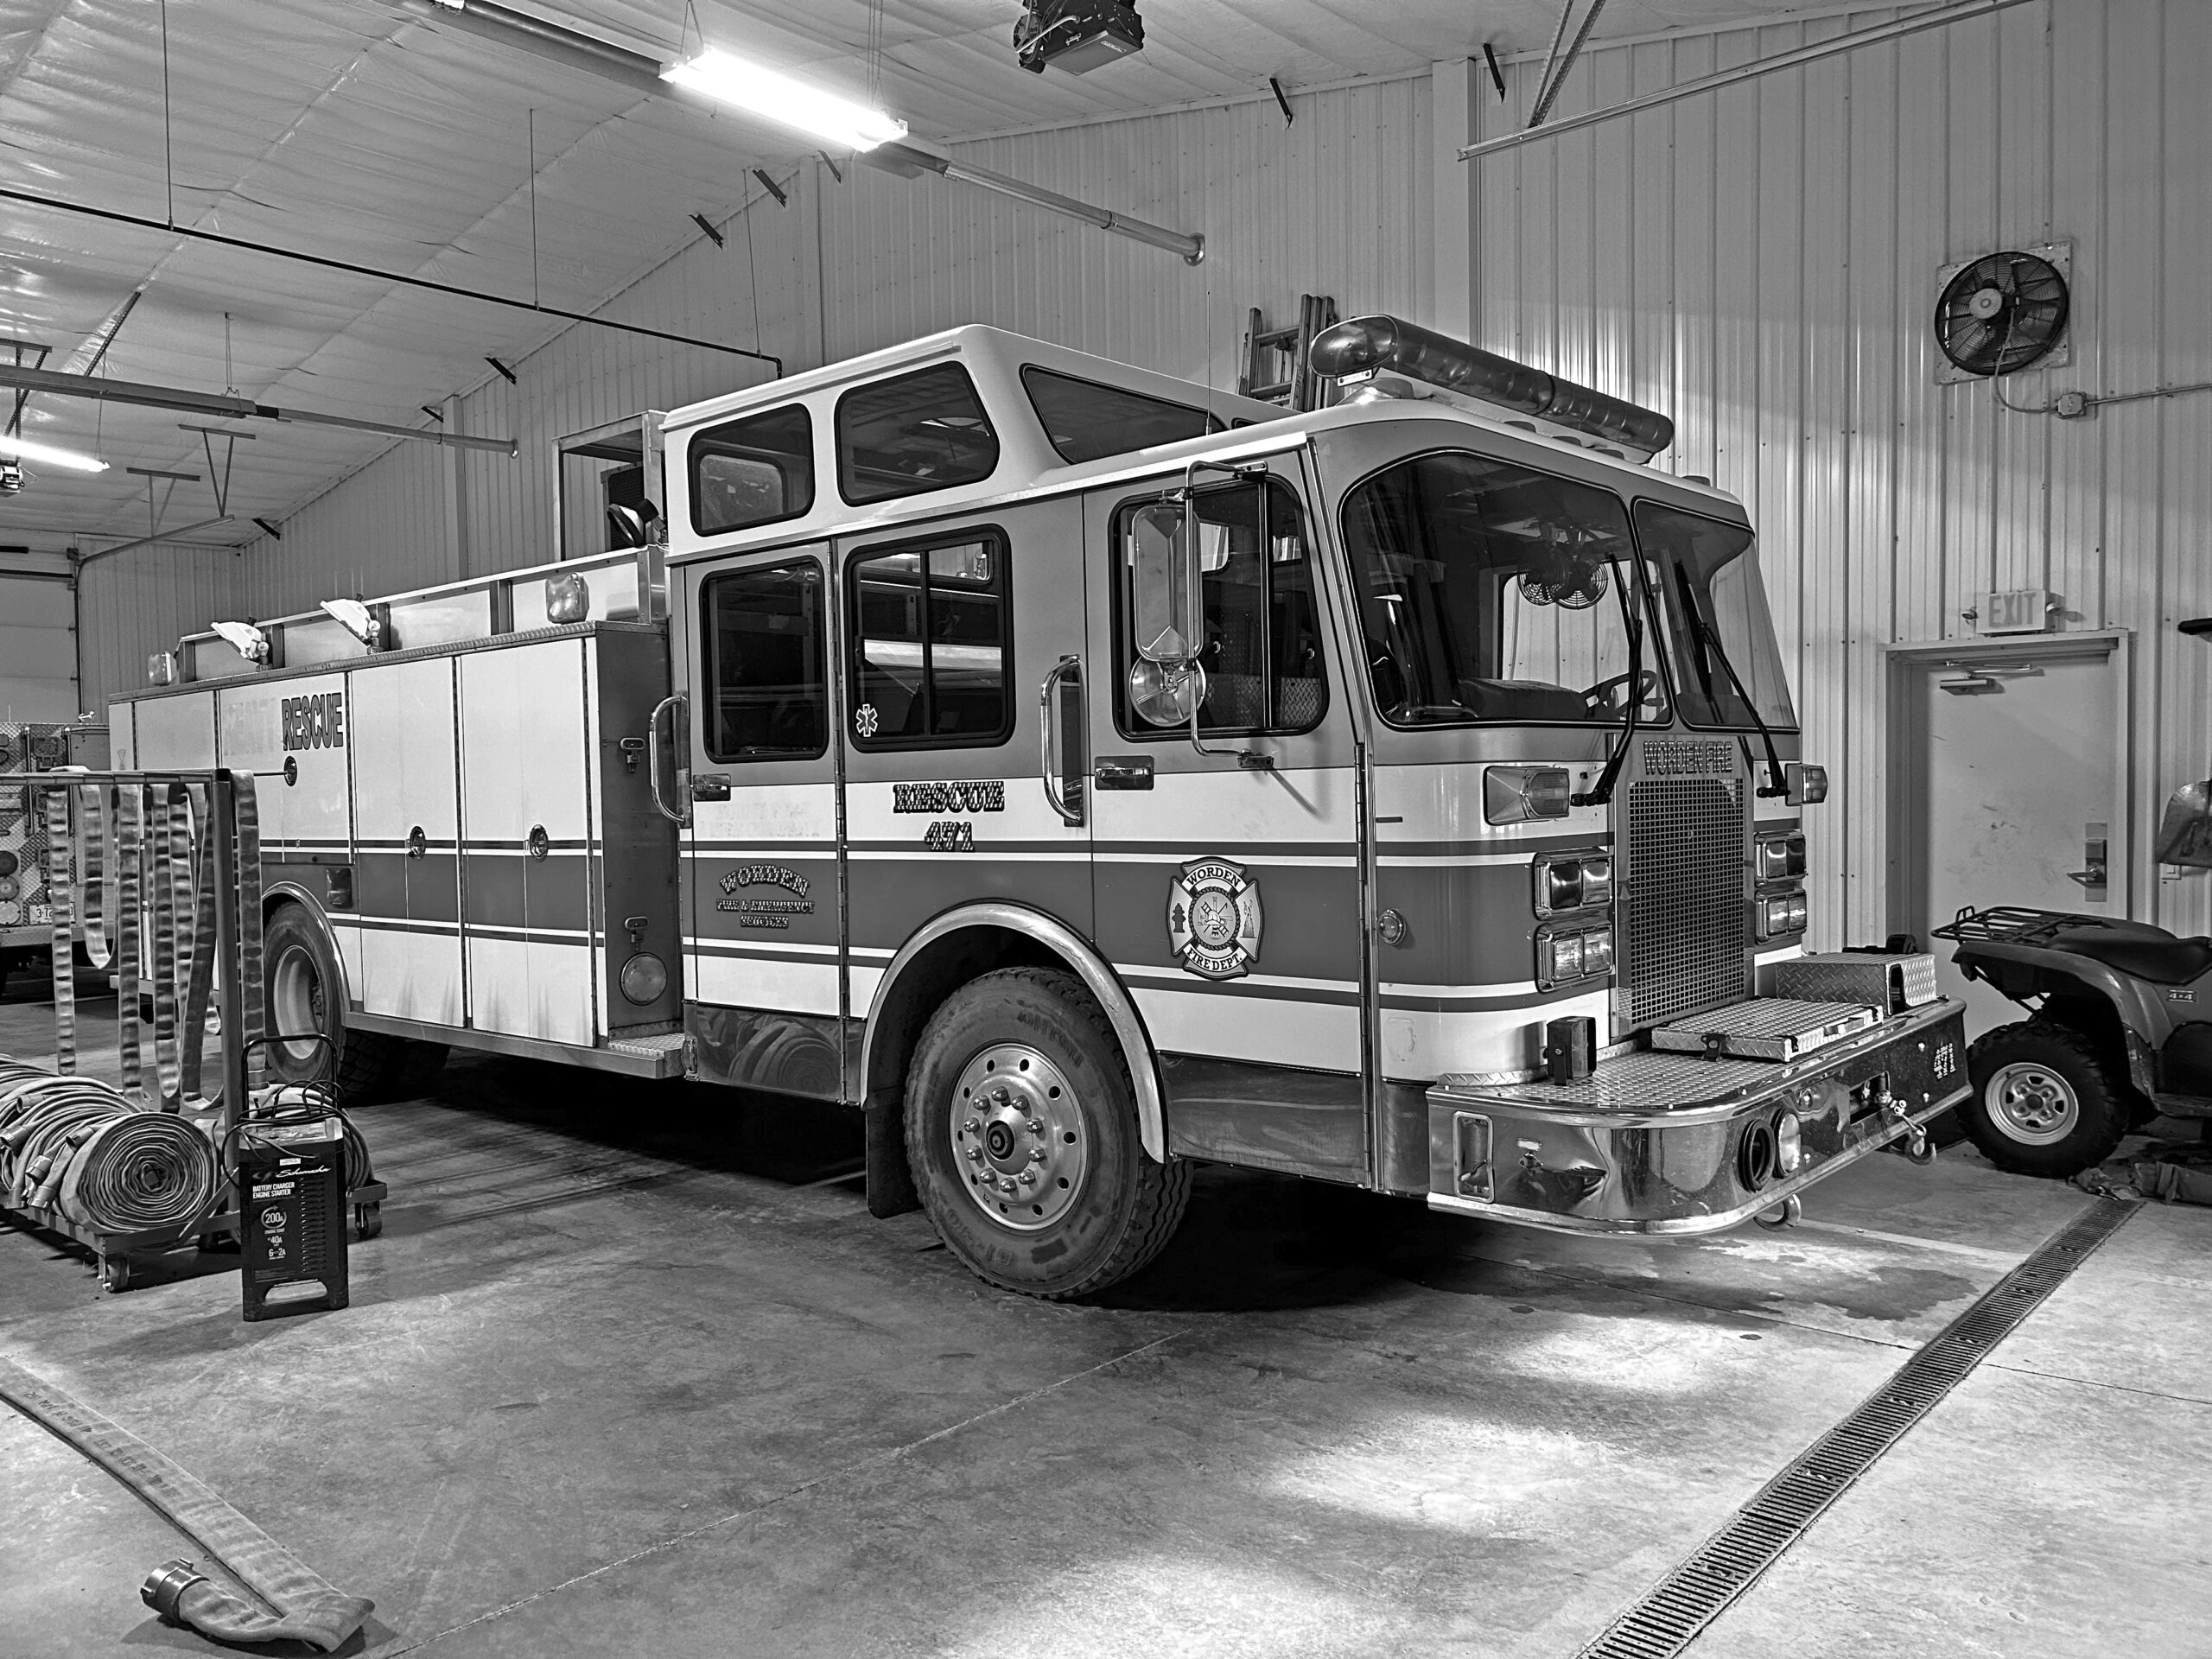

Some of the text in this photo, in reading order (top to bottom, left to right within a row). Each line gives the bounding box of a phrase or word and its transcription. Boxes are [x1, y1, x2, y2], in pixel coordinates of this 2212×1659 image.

[1989, 593, 2036, 628] EXIT
[282, 692, 344, 751] RESCUE
[1643, 741, 1732, 775] WORDEN FIRE
[893, 781, 1005, 813] RESCUE
[924, 821, 975, 852] 471
[719, 864, 810, 899] WORDEN
[1186, 867, 1241, 887] WORDEN
[1186, 948, 1243, 970] FIRE DEPT.
[1933, 1042, 1956, 1079] 471
[252, 1181, 296, 1192] BATTERY CHARGER
[270, 1188, 291, 1197] STARTER
